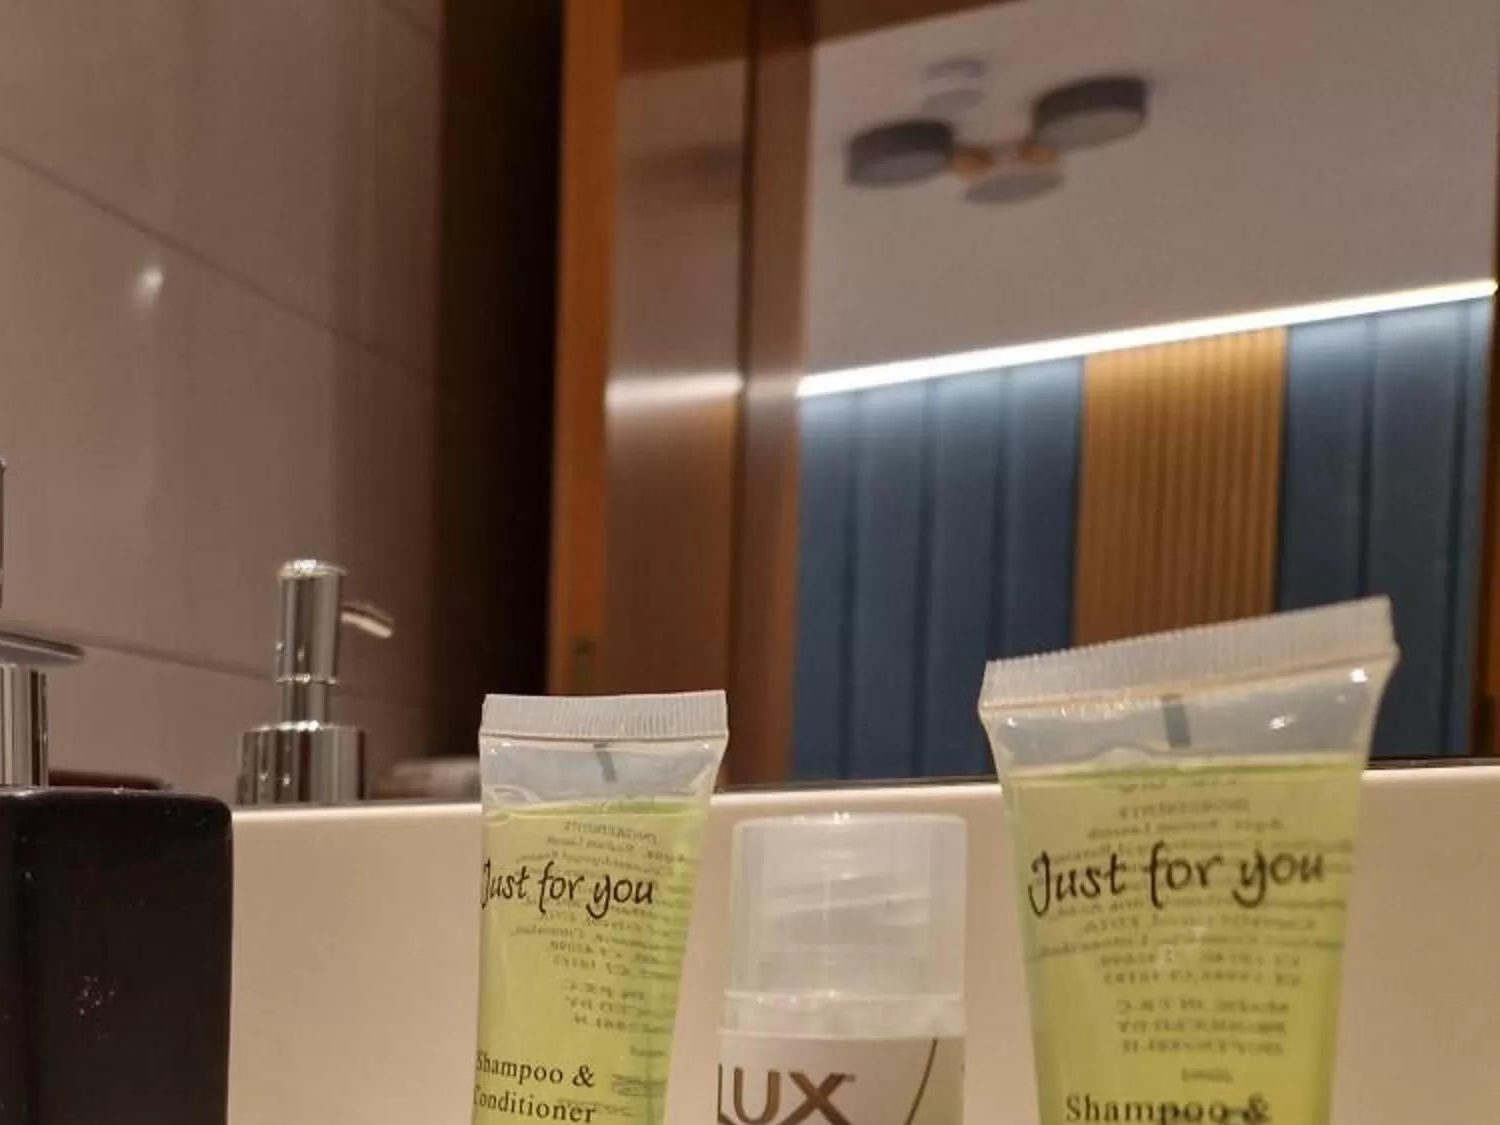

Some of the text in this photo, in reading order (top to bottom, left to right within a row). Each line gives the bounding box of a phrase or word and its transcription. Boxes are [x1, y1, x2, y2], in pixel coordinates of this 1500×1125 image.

[481, 857, 530, 910] Just
[537, 860, 584, 915] for
[586, 873, 653, 920] you
[1028, 849, 1128, 919] Just
[1148, 841, 1227, 909] for
[1232, 849, 1326, 908] you
[476, 1050, 596, 1088] Shampoo &
